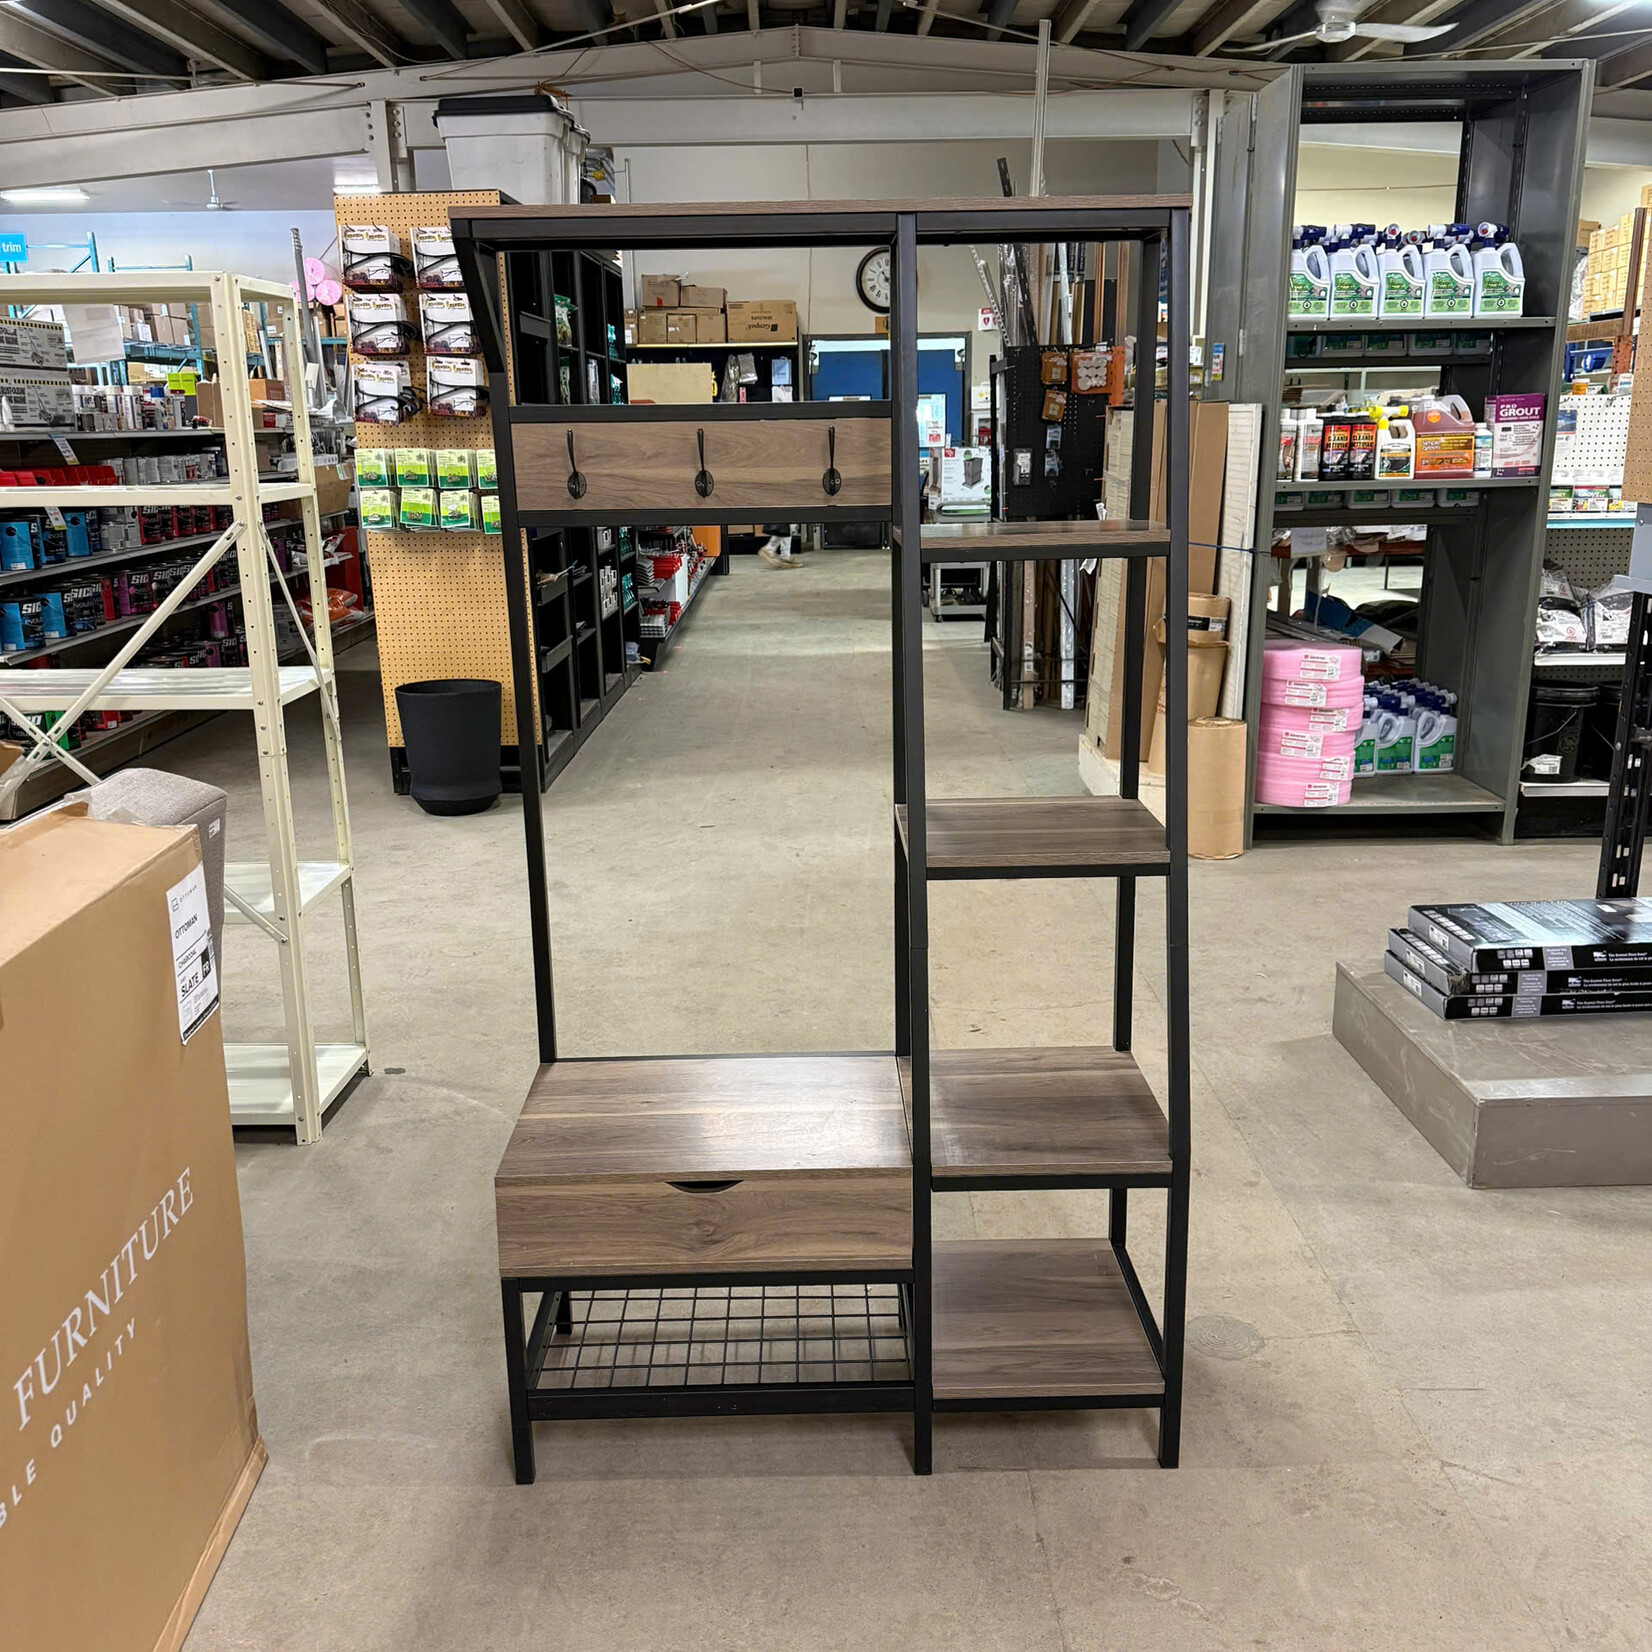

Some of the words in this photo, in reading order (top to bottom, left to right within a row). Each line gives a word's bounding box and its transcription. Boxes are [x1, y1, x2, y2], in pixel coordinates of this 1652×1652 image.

[1, 241, 22, 253] trim
[1499, 407, 1541, 417] GROUT
[174, 913, 198, 940] OTTOMAN
[181, 971, 199, 998] SLATE
[13, 1167, 193, 1431] FURNITURE
[50, 1317, 136, 1449] QUALITY
